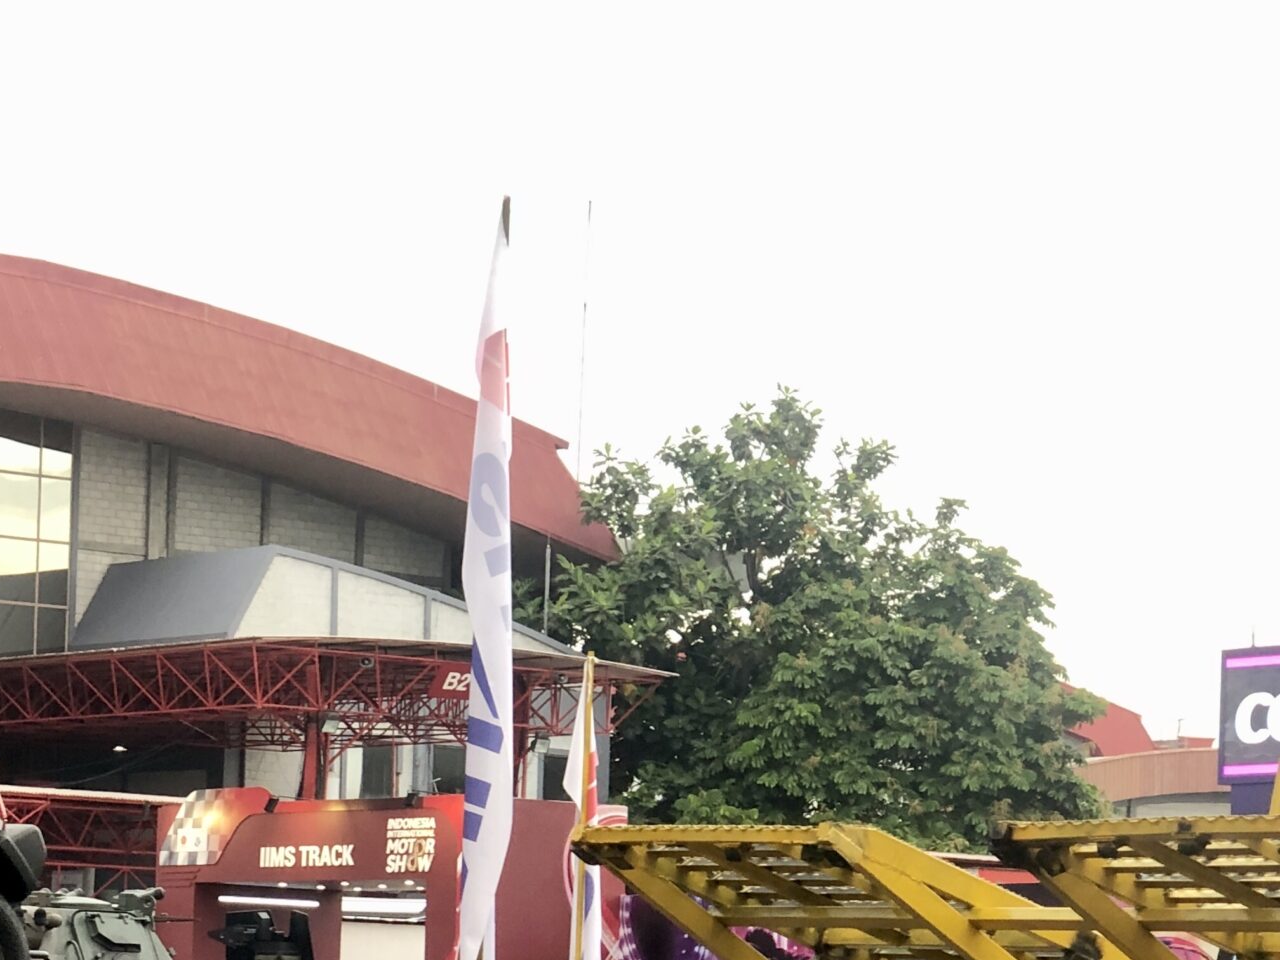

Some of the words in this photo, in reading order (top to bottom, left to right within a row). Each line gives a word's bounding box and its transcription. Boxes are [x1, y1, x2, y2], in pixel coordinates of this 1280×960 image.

[442, 671, 471, 691] B2
[387, 817, 435, 829] INDONESIA
[260, 846, 296, 868] IIMS
[299, 844, 355, 867] TRACK
[386, 838, 435, 854] MOTOR
[385, 853, 434, 873] SHOW
